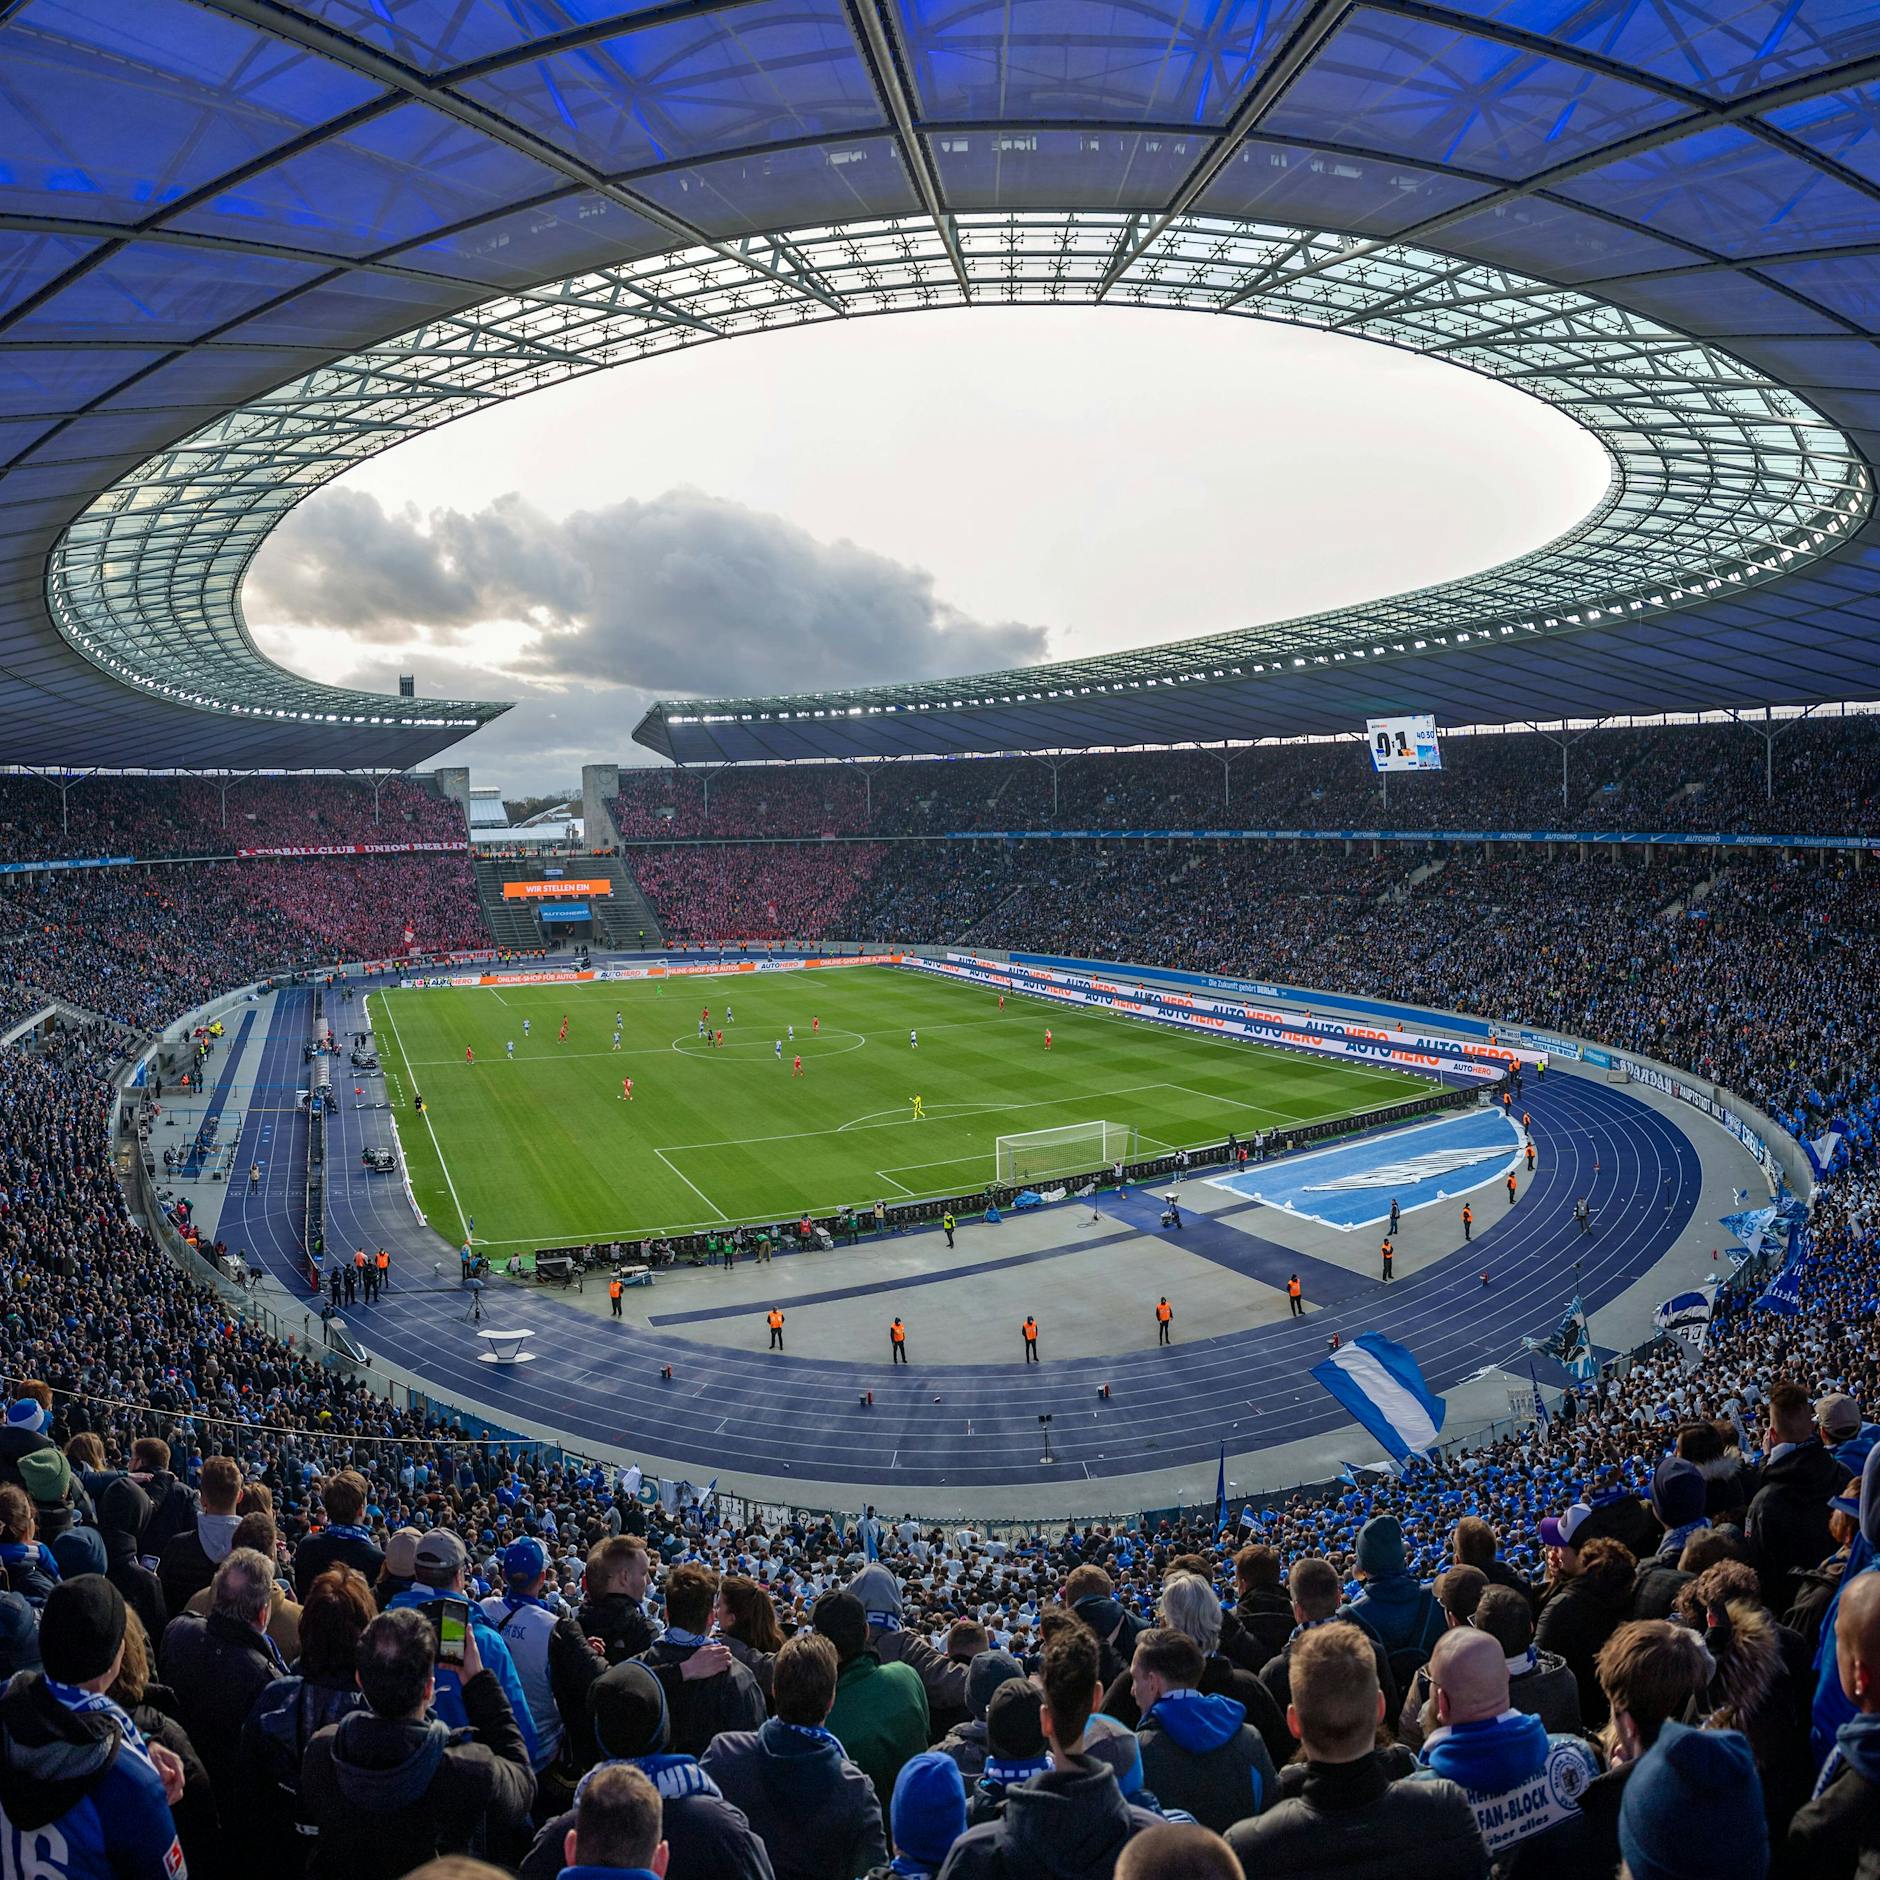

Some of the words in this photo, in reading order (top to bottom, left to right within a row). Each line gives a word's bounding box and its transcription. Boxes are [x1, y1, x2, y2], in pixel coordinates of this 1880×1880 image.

[1684, 834, 1720, 842] AUTOHERO
[1736, 836, 1773, 844] AUTOHERO
[364, 844, 410, 854] UNION
[413, 842, 468, 851] BERLIN
[543, 884, 575, 892] STELLEN
[576, 883, 590, 891] EIN
[720, 964, 740, 972] AUTOS
[762, 961, 798, 969] AUTOHERO
[497, 975, 541, 984] ONLINE-SHOP
[557, 972, 578, 980] AUTOS
[601, 970, 641, 978] AUTOHERO
[1208, 979, 1217, 987] Die
[1218, 980, 1238, 990] Zukunft
[1238, 984, 1257, 993] gehört
[1453, 1063, 1492, 1076] AUTOHERO
[1680, 1084, 1711, 1113] HAUPTSTADT
[511, 1626, 526, 1640] BSC
[1477, 1785, 1550, 1830] FAN-BLOCK
[1519, 1814, 1549, 1833] alles
